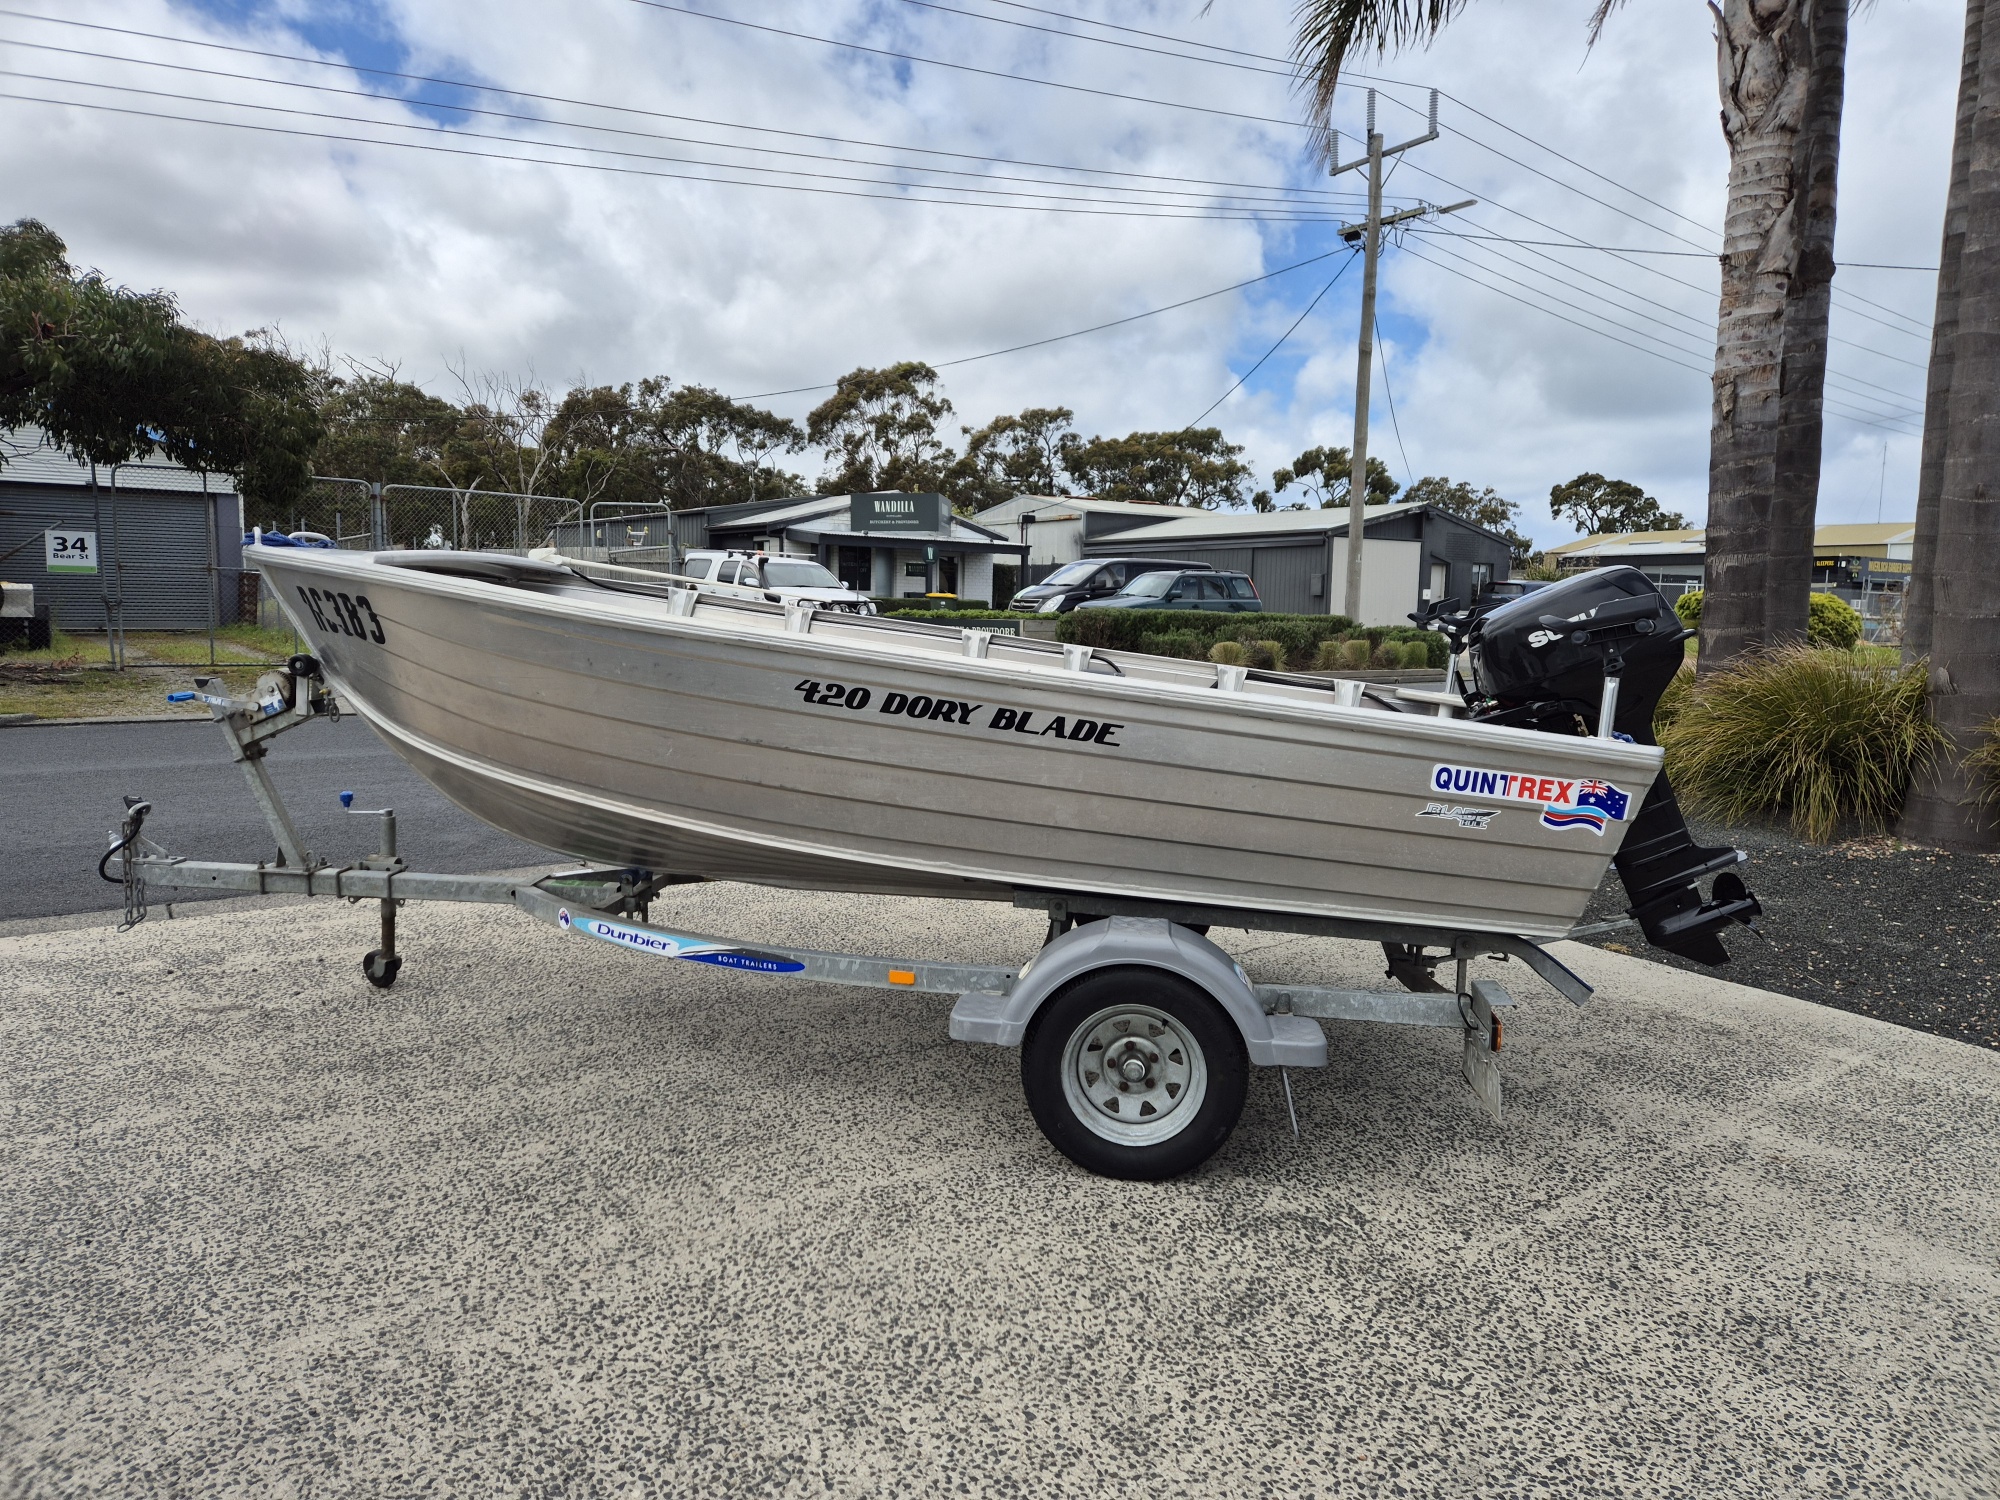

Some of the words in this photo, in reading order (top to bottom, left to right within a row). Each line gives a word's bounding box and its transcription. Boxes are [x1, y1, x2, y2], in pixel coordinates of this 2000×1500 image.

[874, 500, 914, 512] WANDILLA
[53, 536, 88, 552] 34
[794, 679, 871, 710] 420
[879, 692, 983, 725] DORY
[988, 707, 1125, 747] BLADE
[1435, 767, 1574, 804] QUINTREX
[1424, 803, 1494, 821] BLADE
[597, 923, 671, 950] Dunbier
[718, 955, 737, 964] BOAT
[741, 959, 777, 970] TRAILERS
